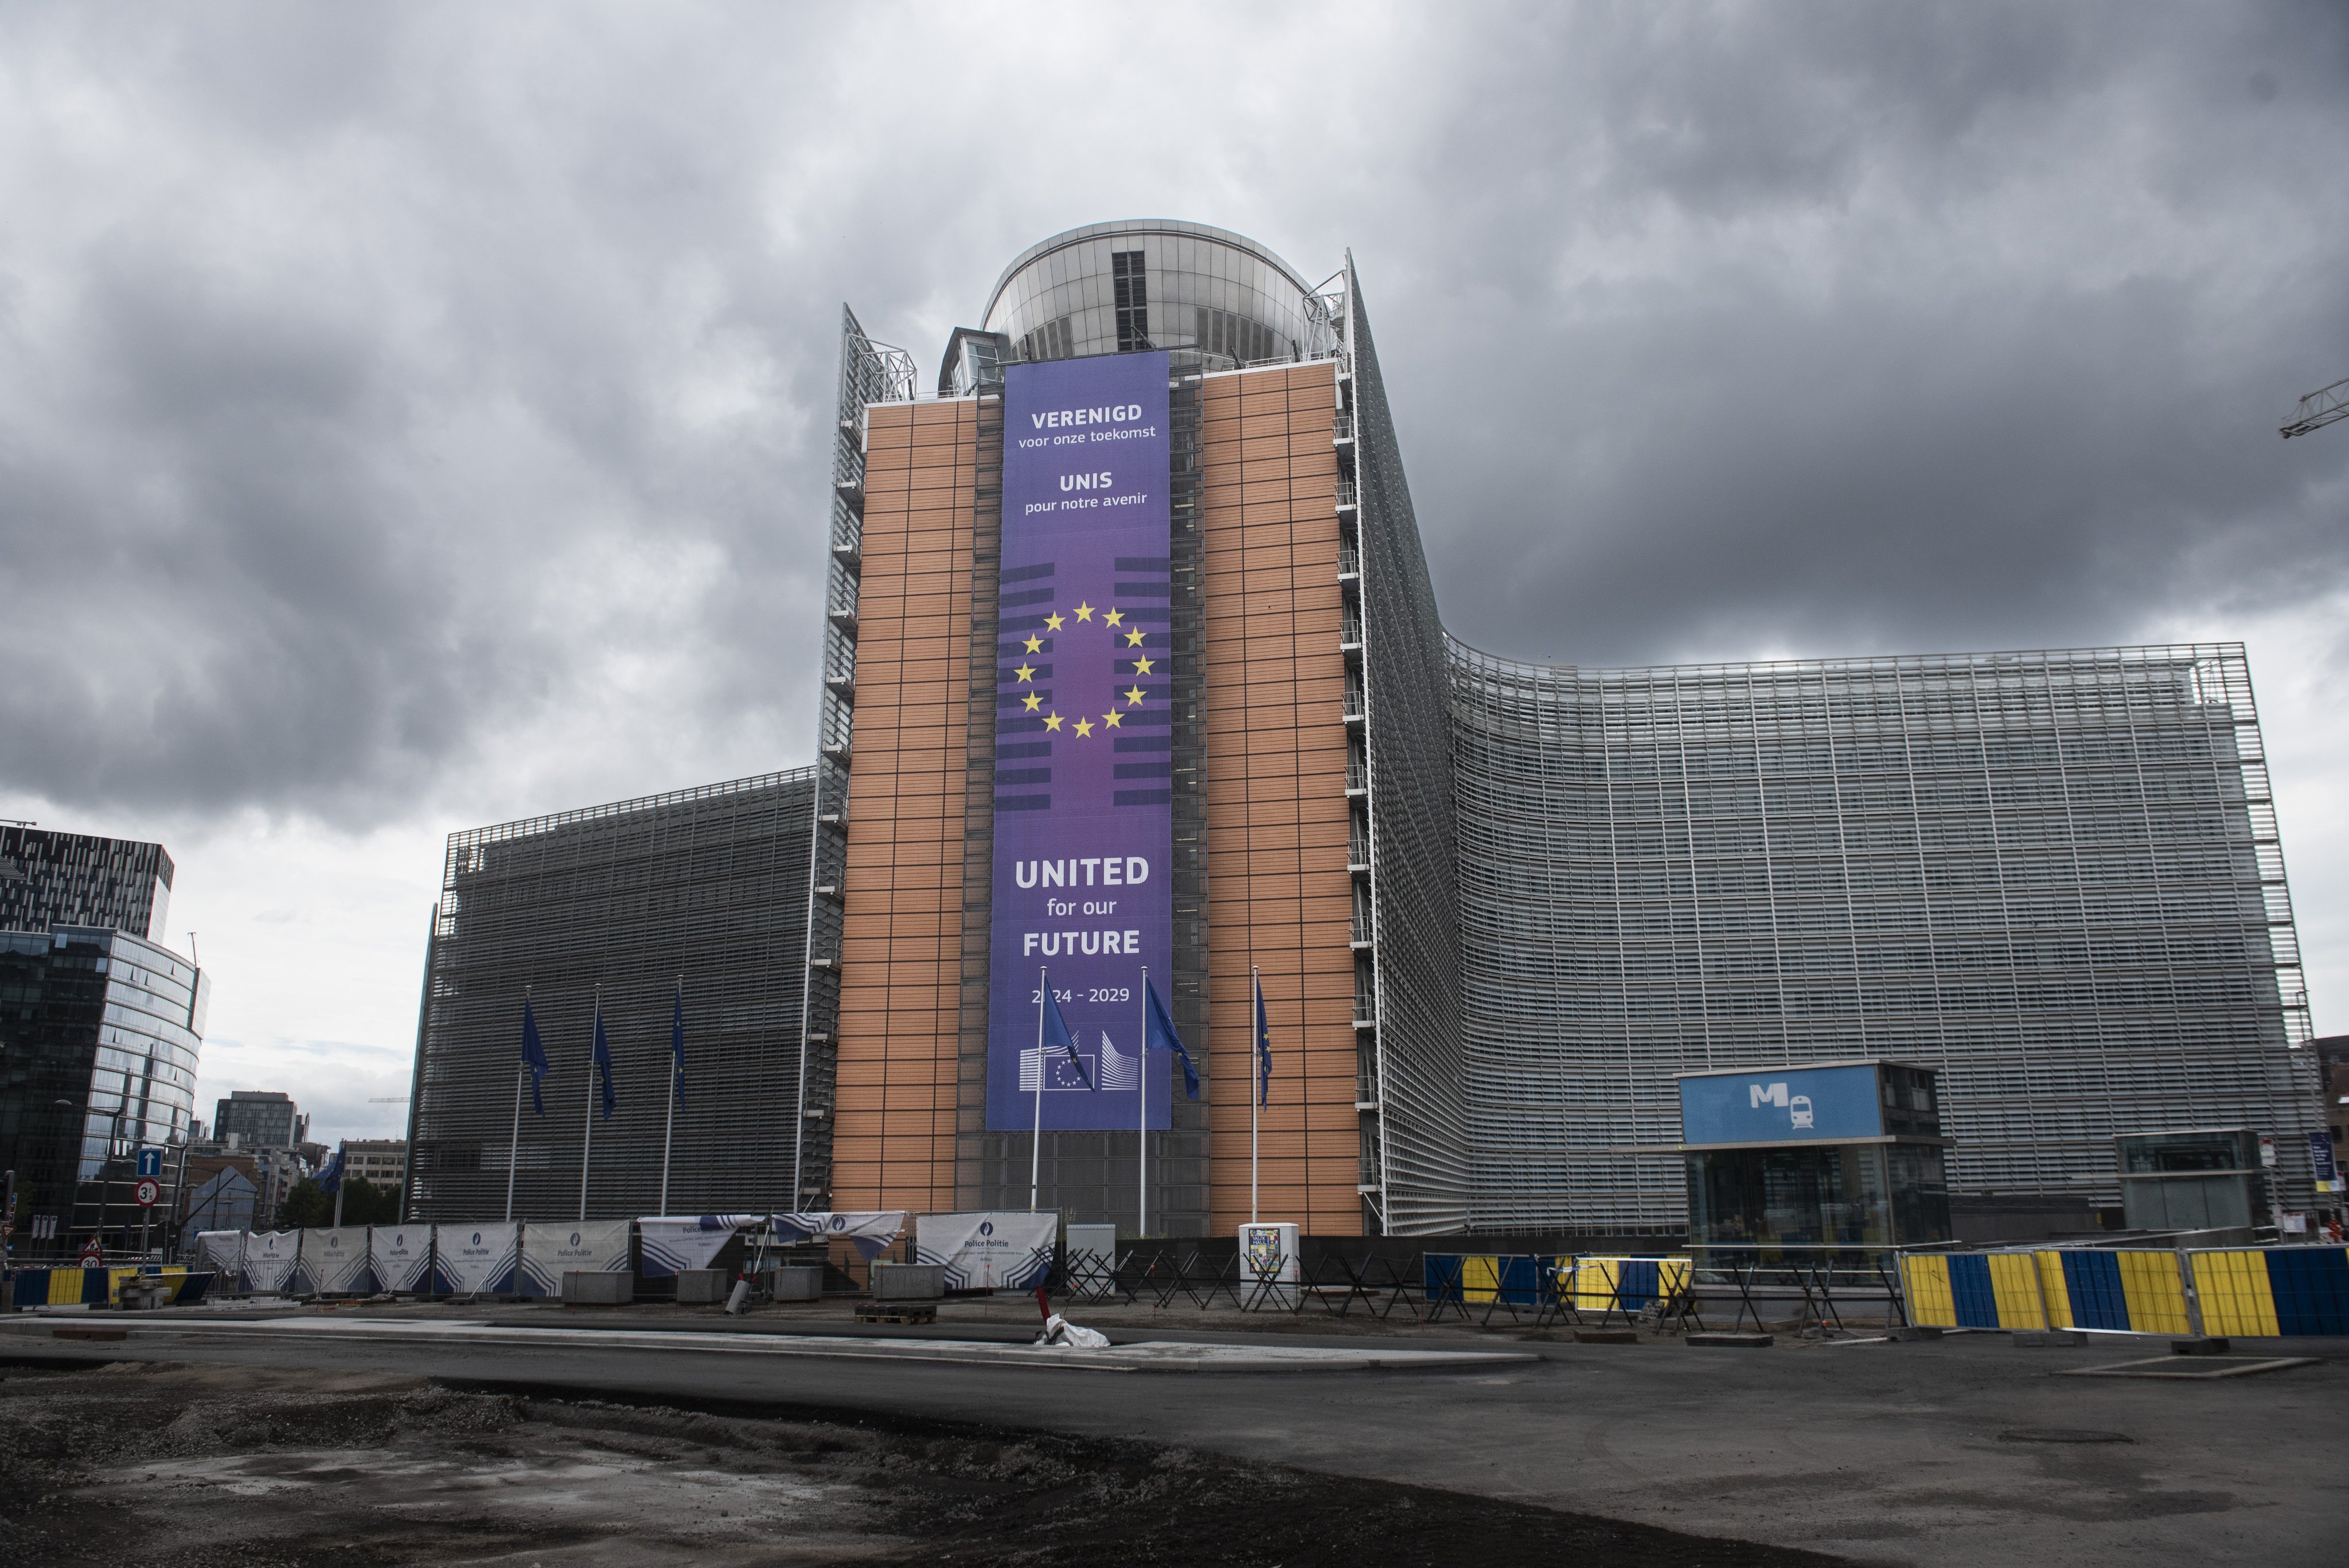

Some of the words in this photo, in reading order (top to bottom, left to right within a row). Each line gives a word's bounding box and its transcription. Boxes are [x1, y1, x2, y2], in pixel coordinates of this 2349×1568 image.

[1032, 404, 1142, 429] VERENIGD
[1019, 436, 1049, 448] voor
[1053, 432, 1085, 445] onze
[1090, 426, 1156, 442] toekomst
[1060, 472, 1113, 491] UNIS
[1025, 500, 1057, 516] pour
[1061, 497, 1098, 510] notre
[1103, 492, 1148, 506] avenir
[1016, 856, 1149, 889] UNITED
[1047, 898, 1076, 916] for
[1083, 900, 1117, 916] our
[1024, 930, 1140, 956] FUTURE
[1032, 989, 1072, 1004] 224
[1089, 988, 1129, 1002] 2029
[1750, 1083, 1789, 1108] M
[986, 1239, 1009, 1247] Politie
[84, 1259, 97, 1267] 30
